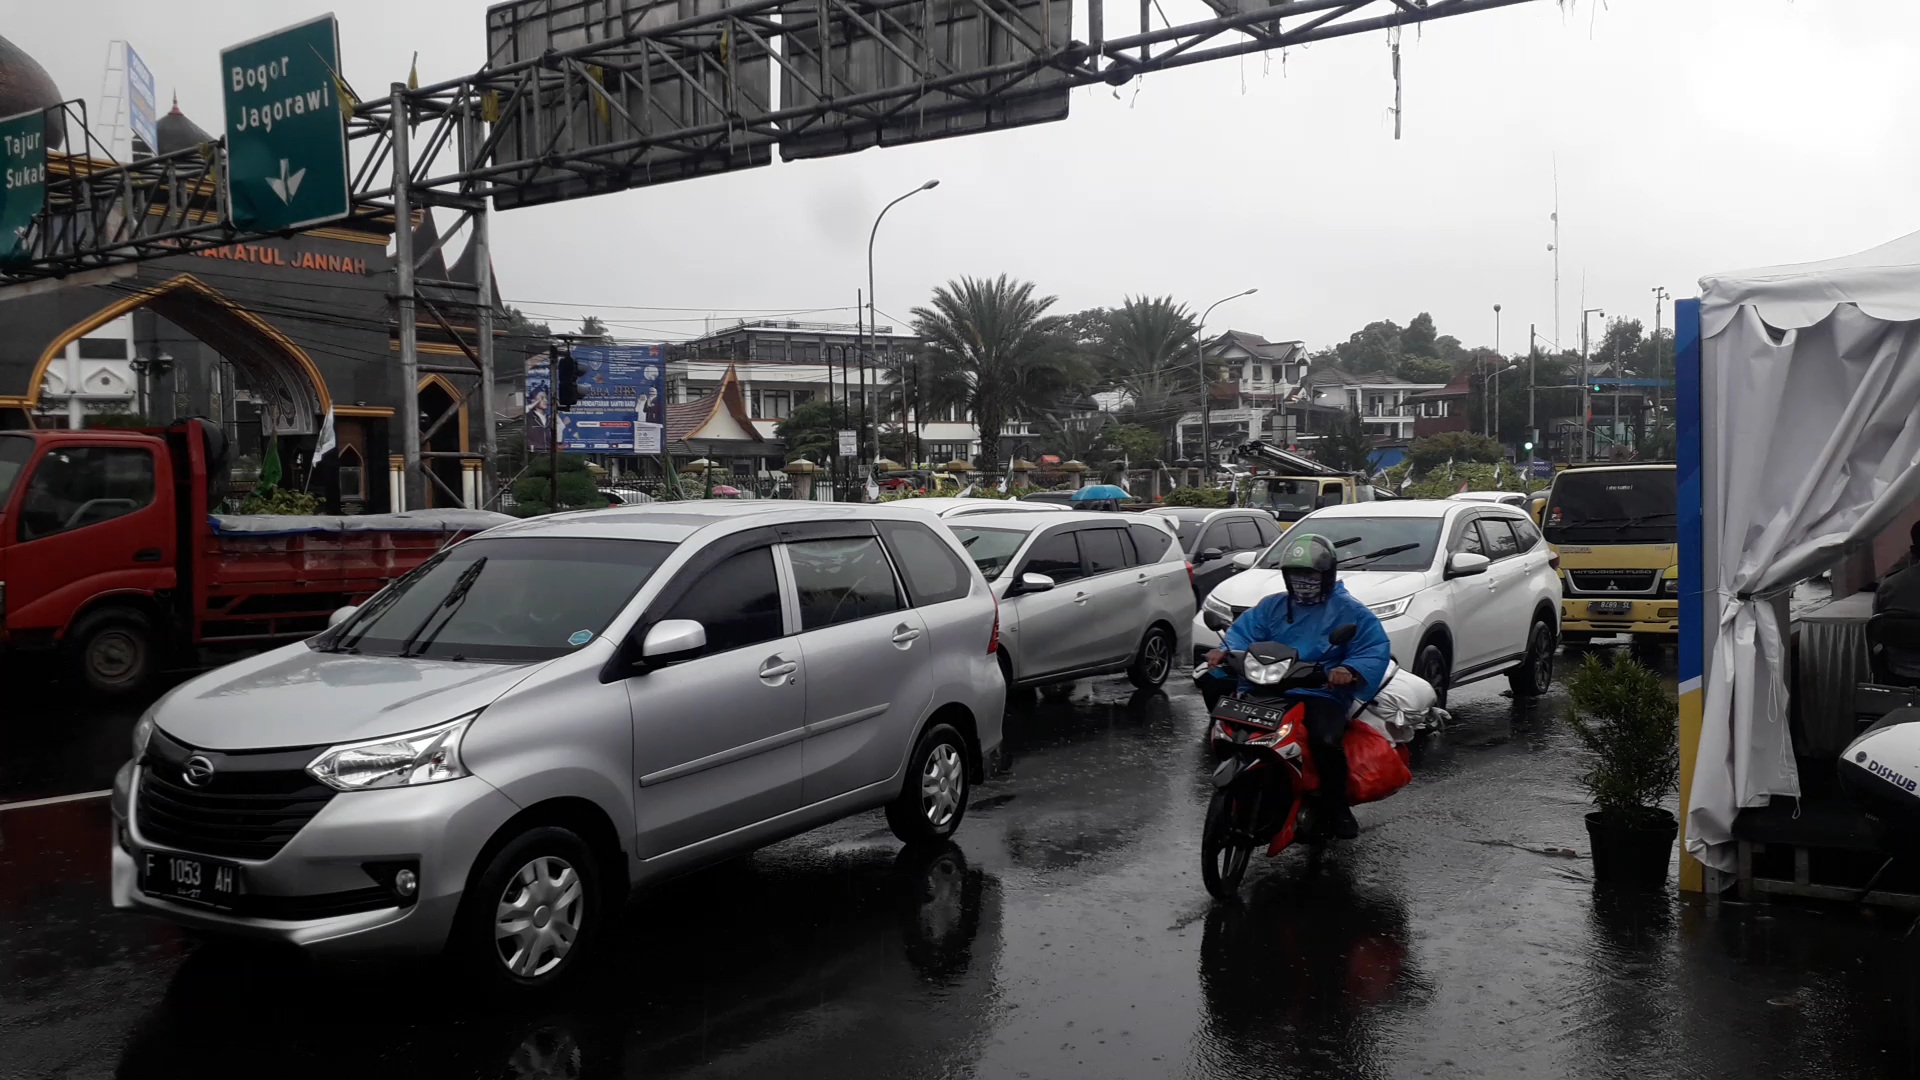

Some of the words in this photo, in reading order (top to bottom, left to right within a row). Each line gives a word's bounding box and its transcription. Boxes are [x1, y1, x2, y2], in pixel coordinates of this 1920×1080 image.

[231, 55, 289, 93] Bogor
[237, 82, 329, 133] Jagorawi
[4, 131, 41, 159] Tajur
[291, 249, 367, 275] JANNAH
[1220, 700, 1229, 708] F
[1264, 710, 1280, 720] EX
[1869, 761, 1917, 791] DISHUB
[146, 854, 155, 877] F
[169, 858, 201, 886] 1053
[214, 866, 234, 893] AH
